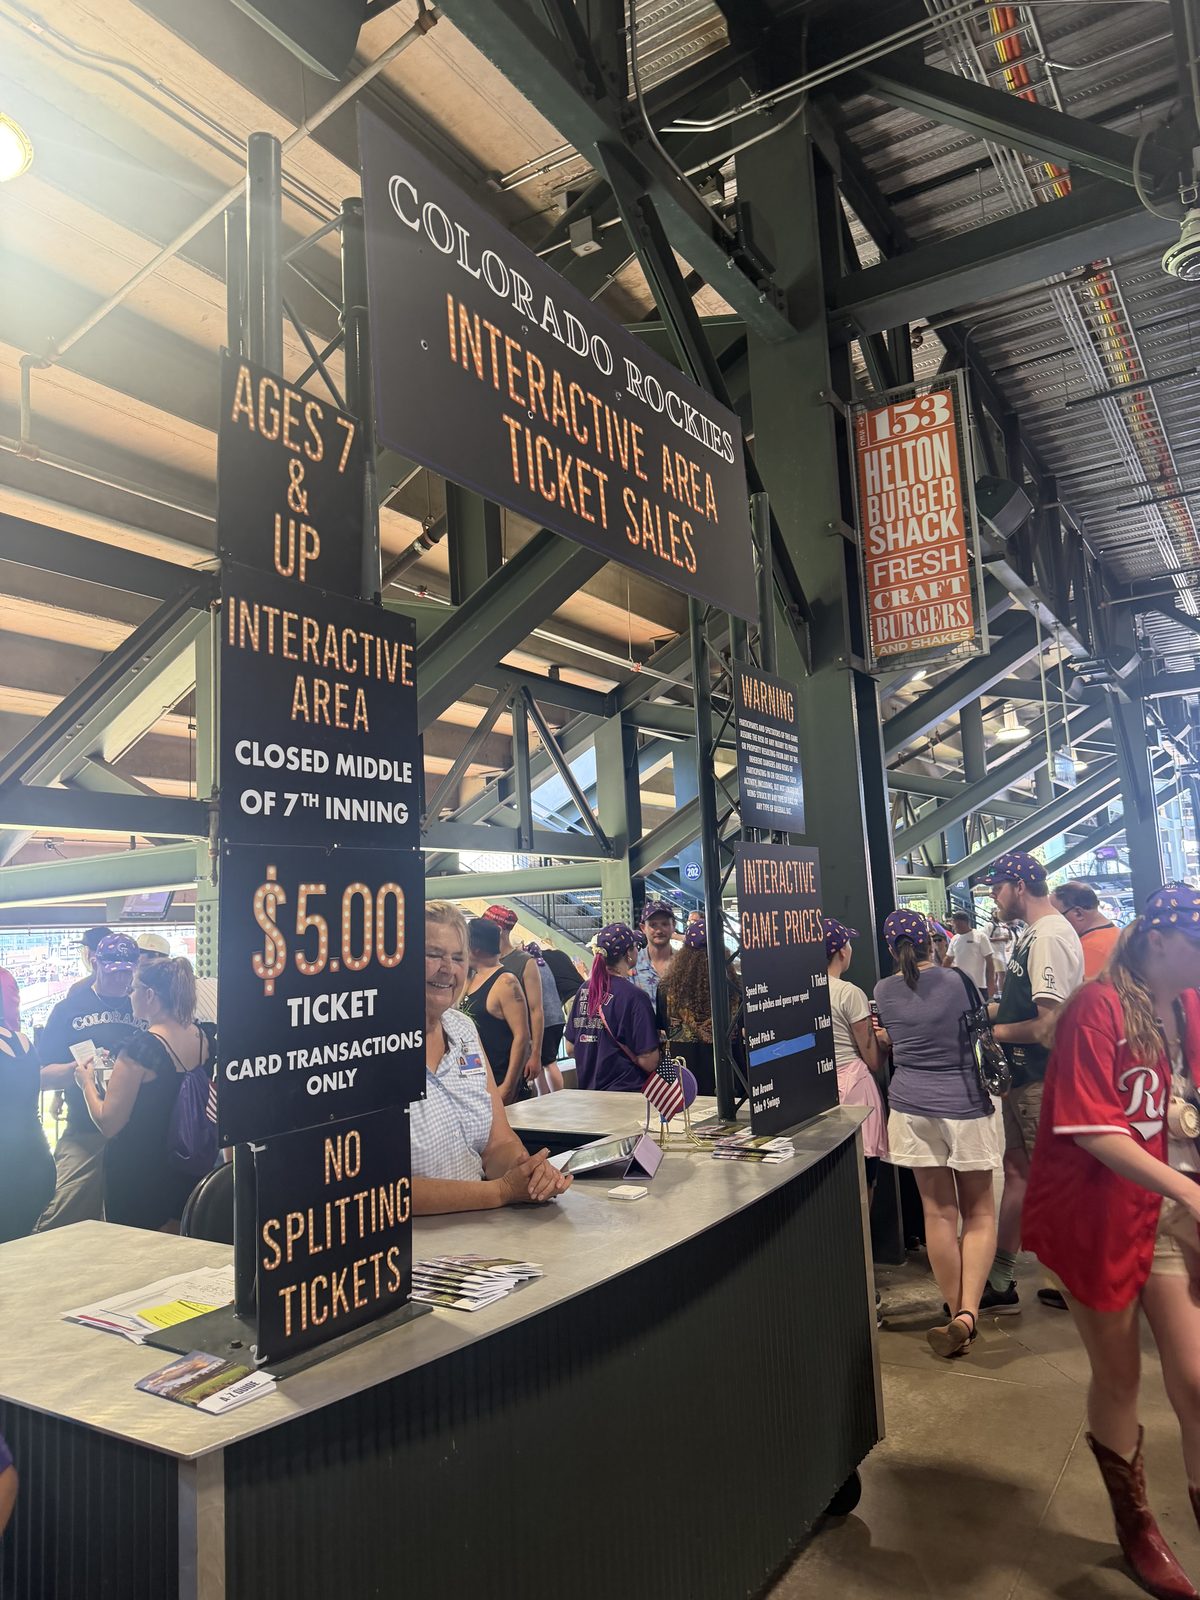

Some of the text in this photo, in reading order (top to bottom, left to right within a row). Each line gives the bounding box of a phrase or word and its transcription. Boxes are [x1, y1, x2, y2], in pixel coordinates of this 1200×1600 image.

[388, 174, 734, 464] COLORADO ROCKIES
[231, 364, 356, 474] AGES 7
[446, 293, 718, 524] INTERACTIVE AREA
[874, 394, 950, 442] 153
[864, 430, 950, 496] HELTON
[288, 458, 308, 515] &
[503, 414, 698, 574] TICKET SALES
[867, 475, 957, 528] BURGER
[274, 513, 320, 581] UP
[869, 507, 960, 555] SHACK
[873, 546, 962, 586] FRESH
[874, 576, 966, 610] CRAFT
[228, 596, 414, 687] INTERACTIVE
[876, 600, 970, 642] BURGERS
[879, 630, 971, 656] AND SHAKES
[290, 675, 370, 733] AREA
[741, 674, 794, 723] WARNING
[234, 739, 412, 784] CLOSED MIDDLE
[240, 788, 408, 824] OF 7TH INNING
[687, 868, 698, 877] 202
[743, 858, 816, 895] INTERACTIVE
[252, 864, 406, 996] $5.00
[741, 908, 824, 950] GAME PRICES
[746, 982, 769, 999] Speed Pitch:
[811, 972, 827, 988] 1 Ticket
[287, 989, 378, 1028] TICKET
[746, 1002, 758, 1013] Throw
[762, 997, 774, 1012] pitches
[782, 996, 791, 1007] guess
[814, 1014, 831, 1030] 1 Ticket
[226, 1030, 424, 1083] CARD TRANSACTIONS
[749, 1032, 760, 1048] Speed
[761, 1030, 770, 1043] Pitch
[306, 1069, 358, 1096] ONLY
[760, 1079, 774, 1094] Around
[817, 1058, 834, 1074] 1 Ticket
[753, 1101, 763, 1114] Take
[767, 1096, 780, 1108] Swings
[324, 1130, 362, 1186] NO
[262, 1176, 410, 1272] SPLITTING
[278, 1246, 402, 1338] TICKETS
